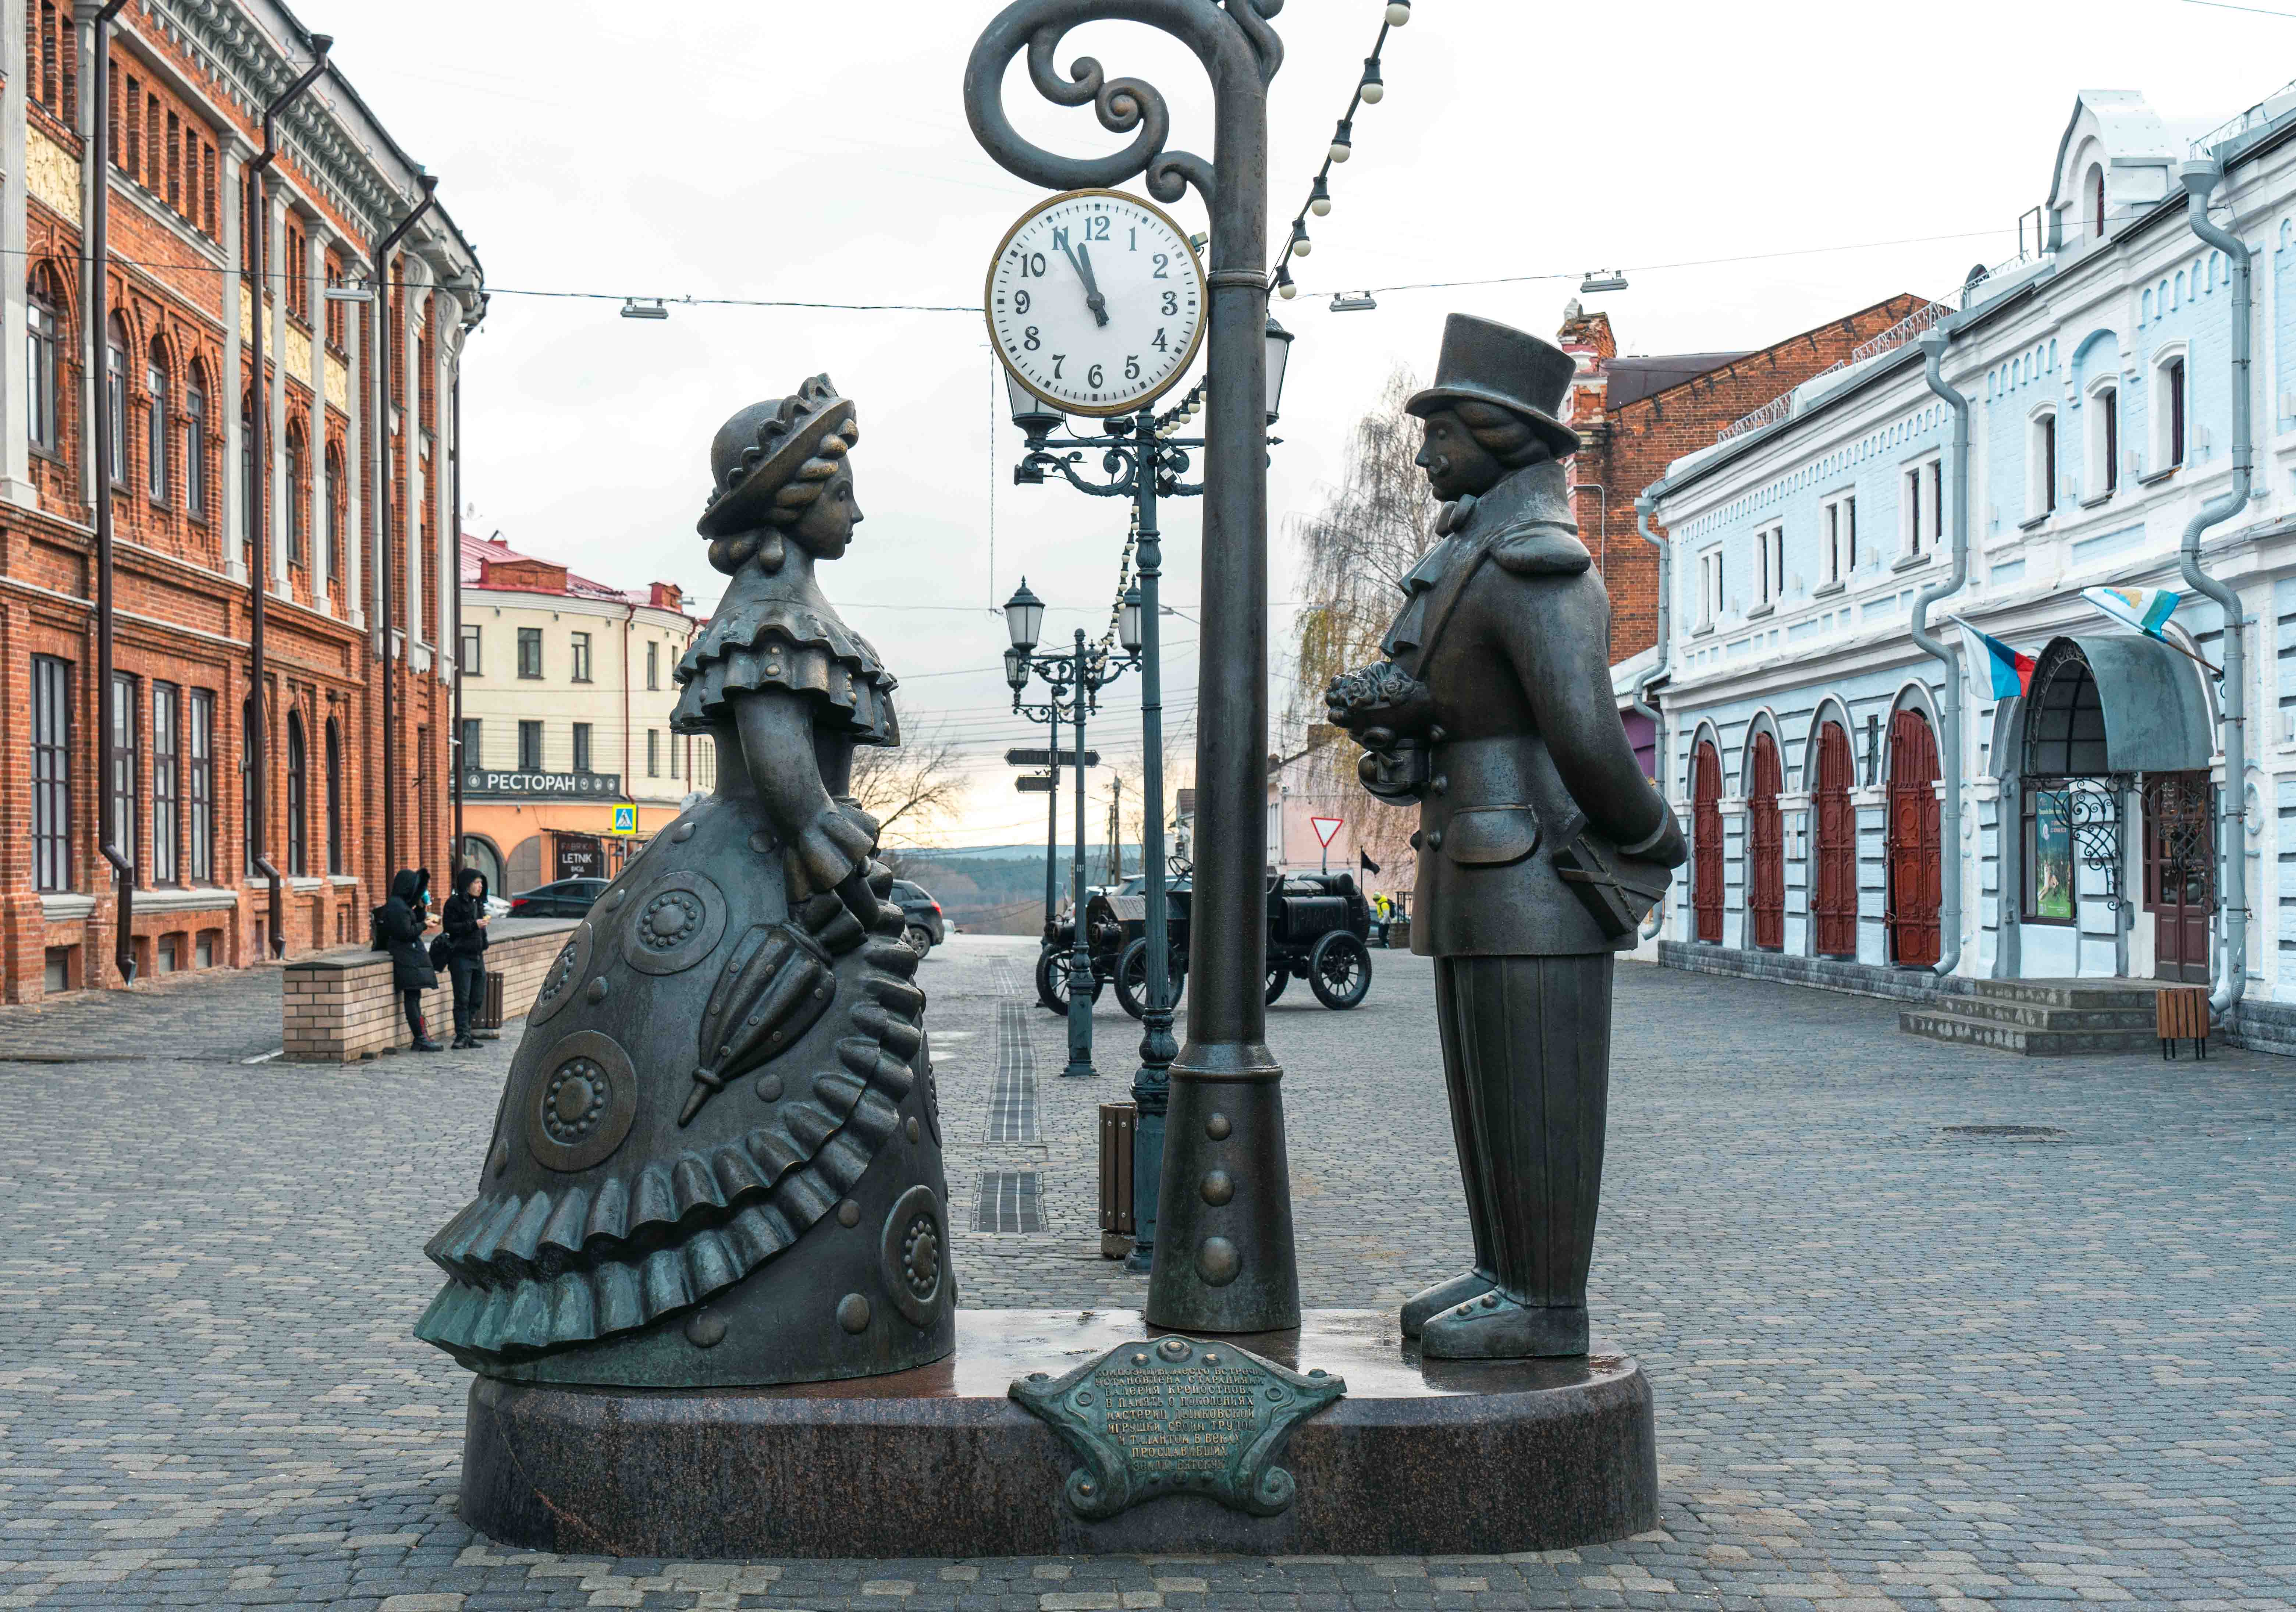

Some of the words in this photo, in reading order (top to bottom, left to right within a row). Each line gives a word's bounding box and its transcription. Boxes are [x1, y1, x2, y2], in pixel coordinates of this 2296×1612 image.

[1052, 226, 1068, 250] 11
[1085, 216, 1110, 241] 12
[1129, 227, 1137, 251] 1
[1021, 253, 1046, 277] 10
[1153, 253, 1168, 278] 2
[1015, 290, 1030, 314] 9
[1161, 291, 1177, 315] 3
[1024, 326, 1041, 350] 8
[1151, 327, 1168, 352] 4
[1052, 355, 1066, 379] 7
[1088, 364, 1103, 389] 6
[1125, 355, 1140, 379] 5
[487, 774, 575, 791] РЕСТОРАН
[562, 853, 592, 863] LETNIK
[1095, 1376, 1180, 1386] УСТАНОВЛЕНА
[1188, 1376, 1264, 1385] СТАРАНИЯМИ
[1106, 1386, 1159, 1396] ВАЛЕРИЯ
[1168, 1385, 1253, 1395] КРЕПОСТНОВА
[1106, 1398, 1112, 1408] В
[1118, 1397, 1163, 1408] ПАМЯТЬ
[1168, 1397, 1174, 1407] О
[1180, 1396, 1254, 1407] ПОКОЛЕНИЯХ
[1106, 1410, 1167, 1421] МАСТЕРИЦ
[1174, 1406, 1254, 1421] ДЫМКОВСКОЙ
[1118, 1435, 1124, 1445] И
[1130, 1434, 1189, 1445] ТАЛАНТОМ
[1195, 1434, 1201, 1444] В
[1205, 1431, 1240, 1444] ВЕКАХ
[1168, 1421, 1204, 1432] СВОИМ
[1132, 1446, 1229, 1458] ПРОСЛАВИВШИХ
